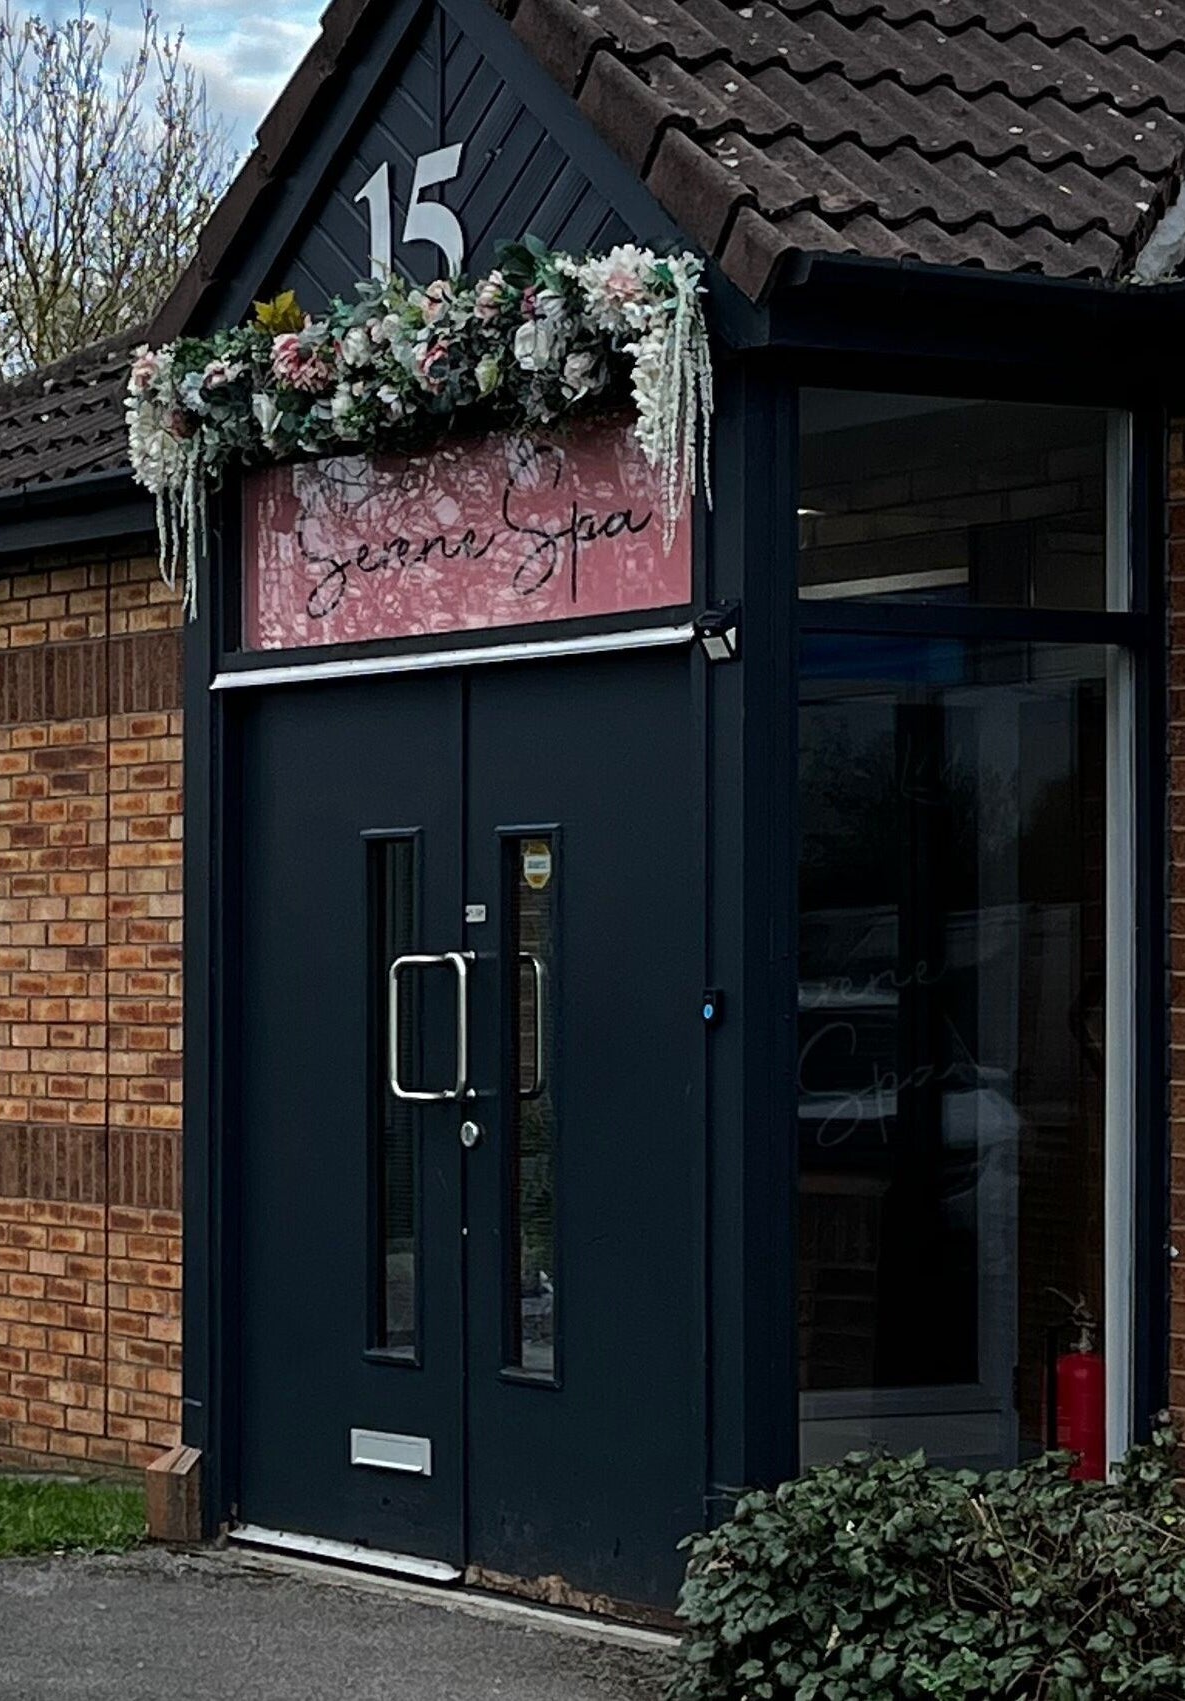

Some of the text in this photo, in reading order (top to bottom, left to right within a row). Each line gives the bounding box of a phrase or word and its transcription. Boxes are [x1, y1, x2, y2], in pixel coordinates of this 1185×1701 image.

[354, 142, 464, 290] 15
[297, 445, 653, 619] Serene Spa
